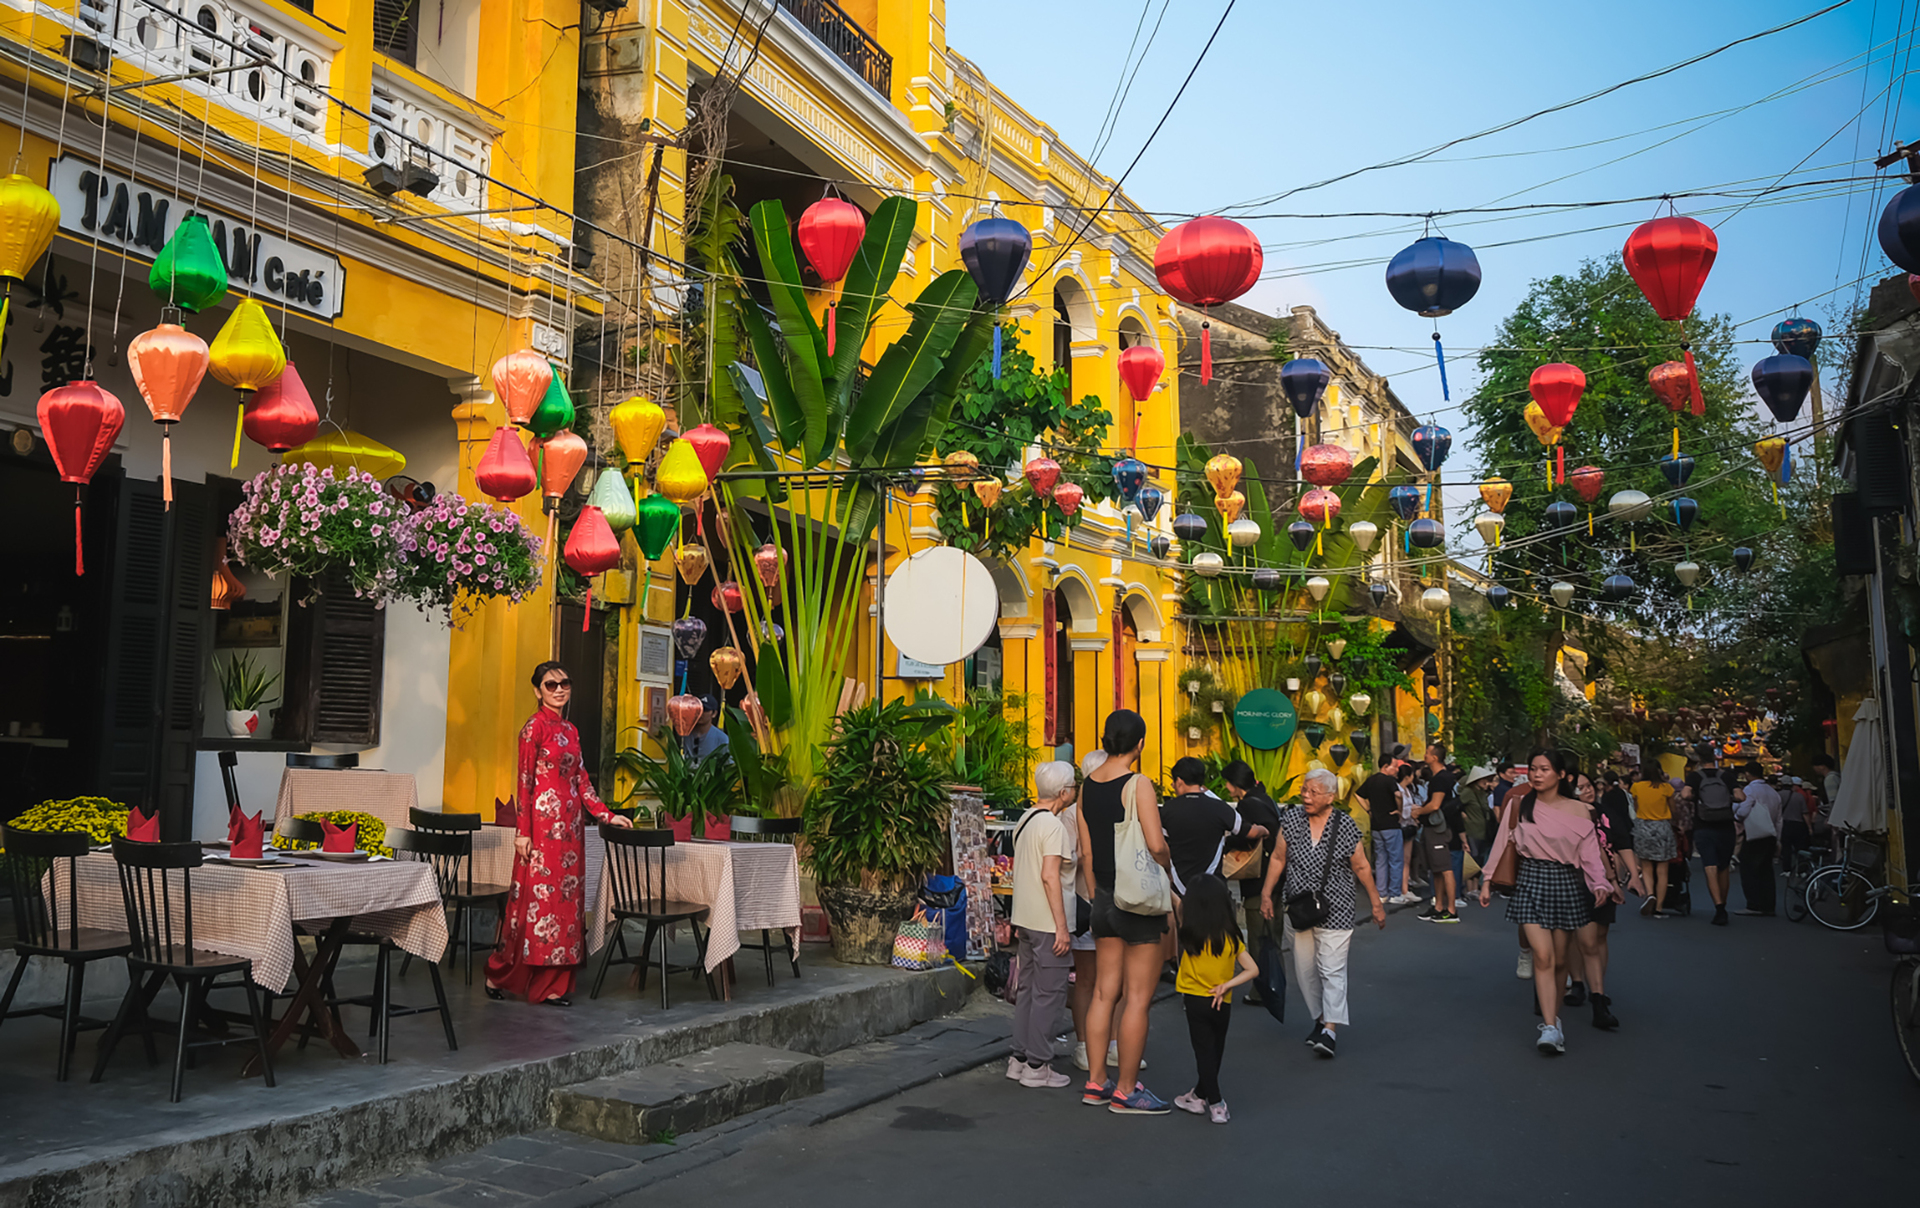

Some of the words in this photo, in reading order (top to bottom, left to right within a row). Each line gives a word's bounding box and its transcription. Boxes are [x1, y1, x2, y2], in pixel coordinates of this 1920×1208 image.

[264, 256, 324, 306] Café
[1236, 710, 1270, 718] MORNING
[1271, 711, 1293, 719] GLORY
